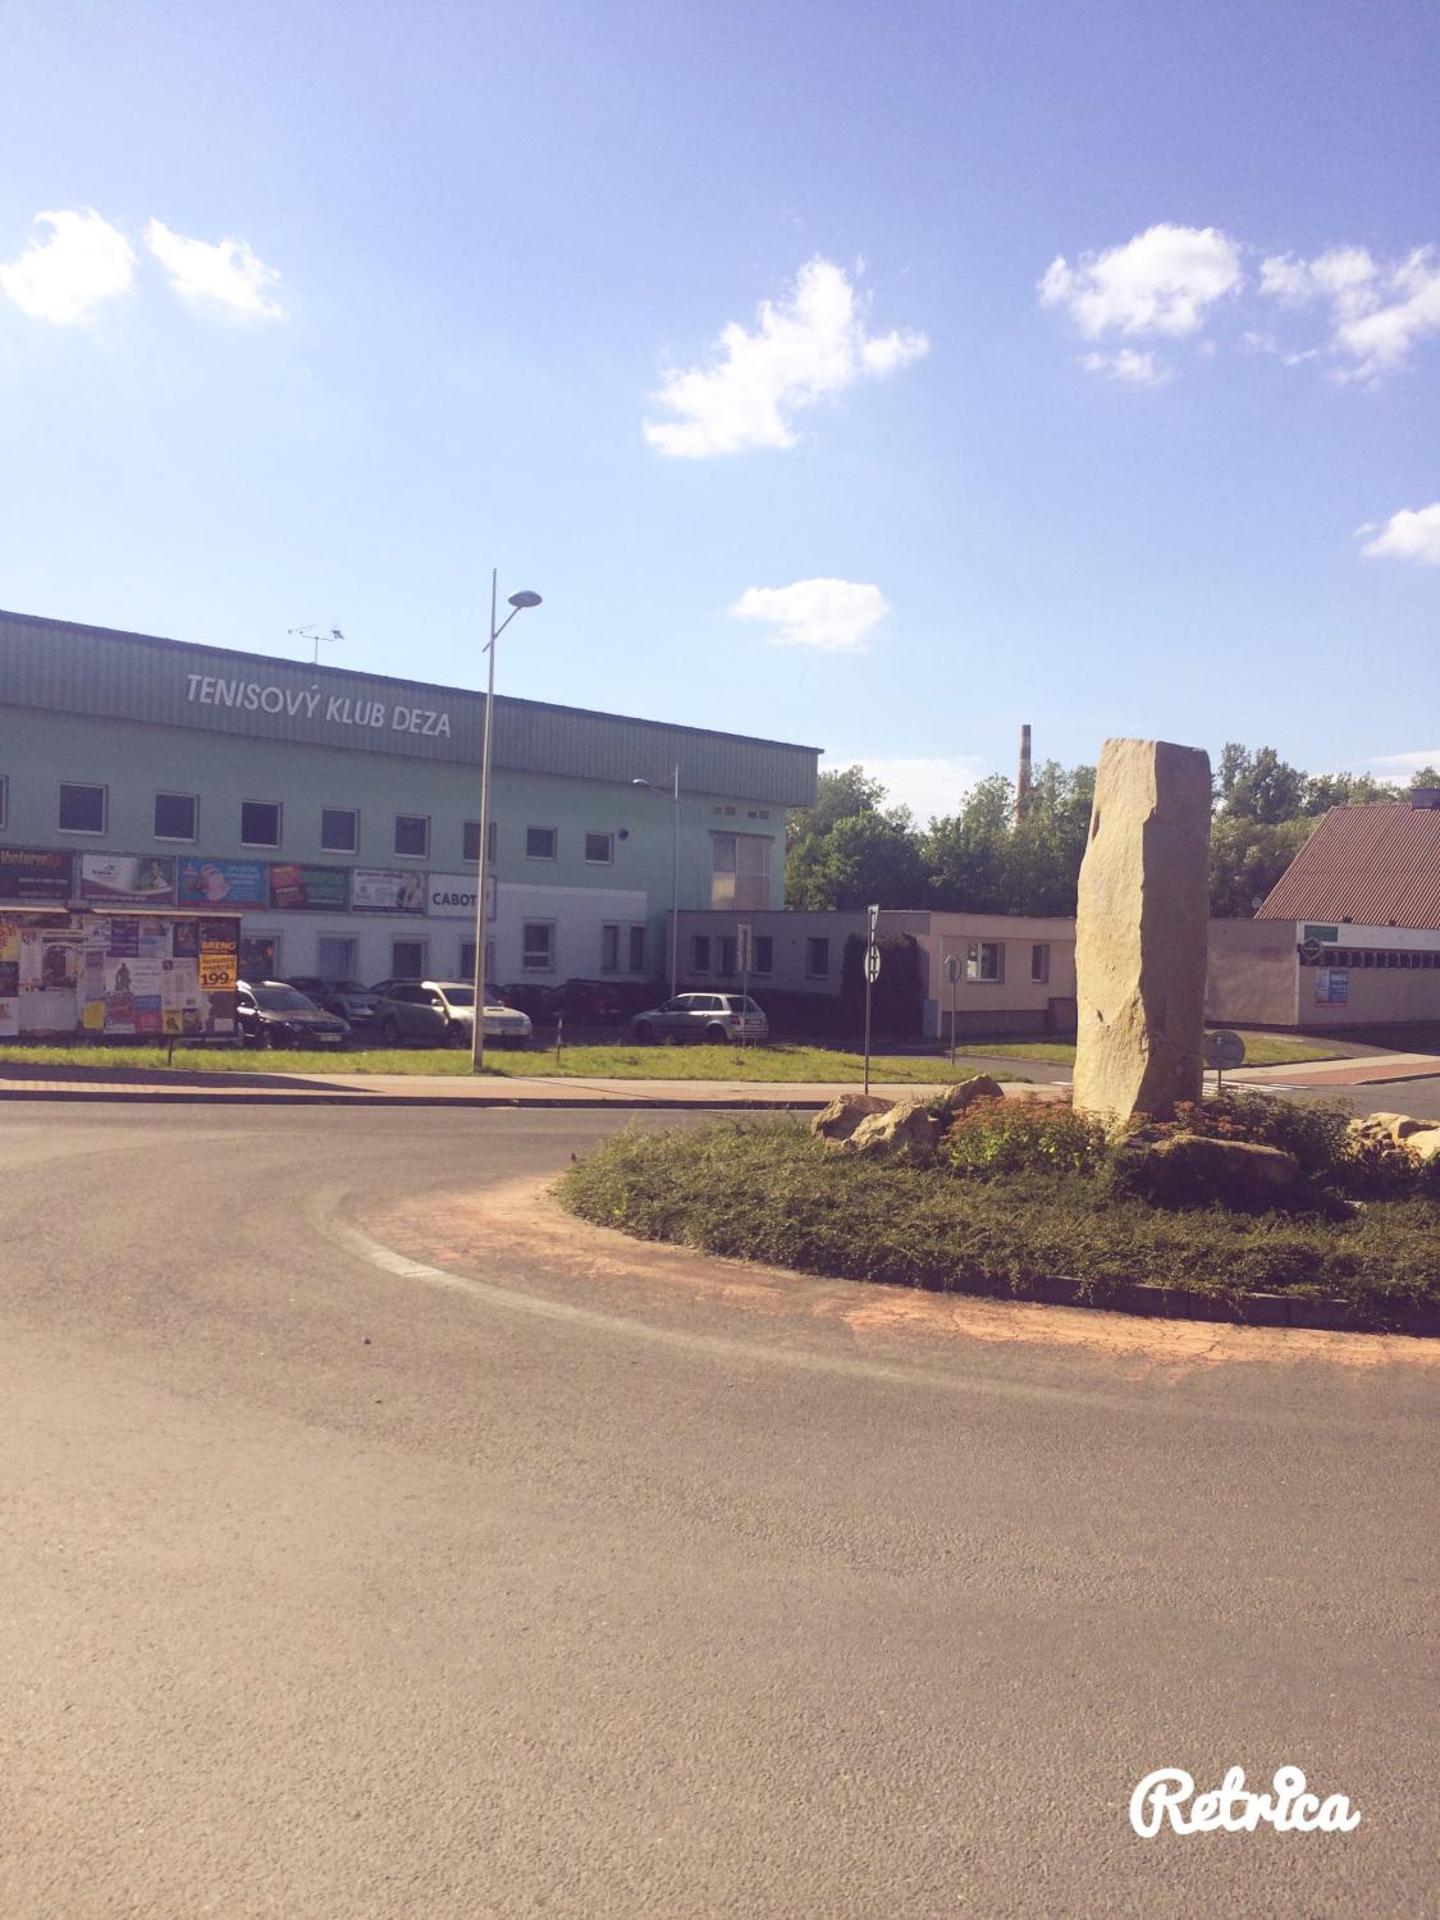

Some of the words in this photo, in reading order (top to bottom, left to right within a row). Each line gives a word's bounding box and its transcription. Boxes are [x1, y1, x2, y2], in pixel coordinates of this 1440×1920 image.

[186, 674, 320, 718] TENISOVÝ
[326, 696, 384, 728] KLUB
[391, 706, 451, 738] DEZA
[432, 892, 478, 907] CABOT
[200, 972, 229, 986] 199
